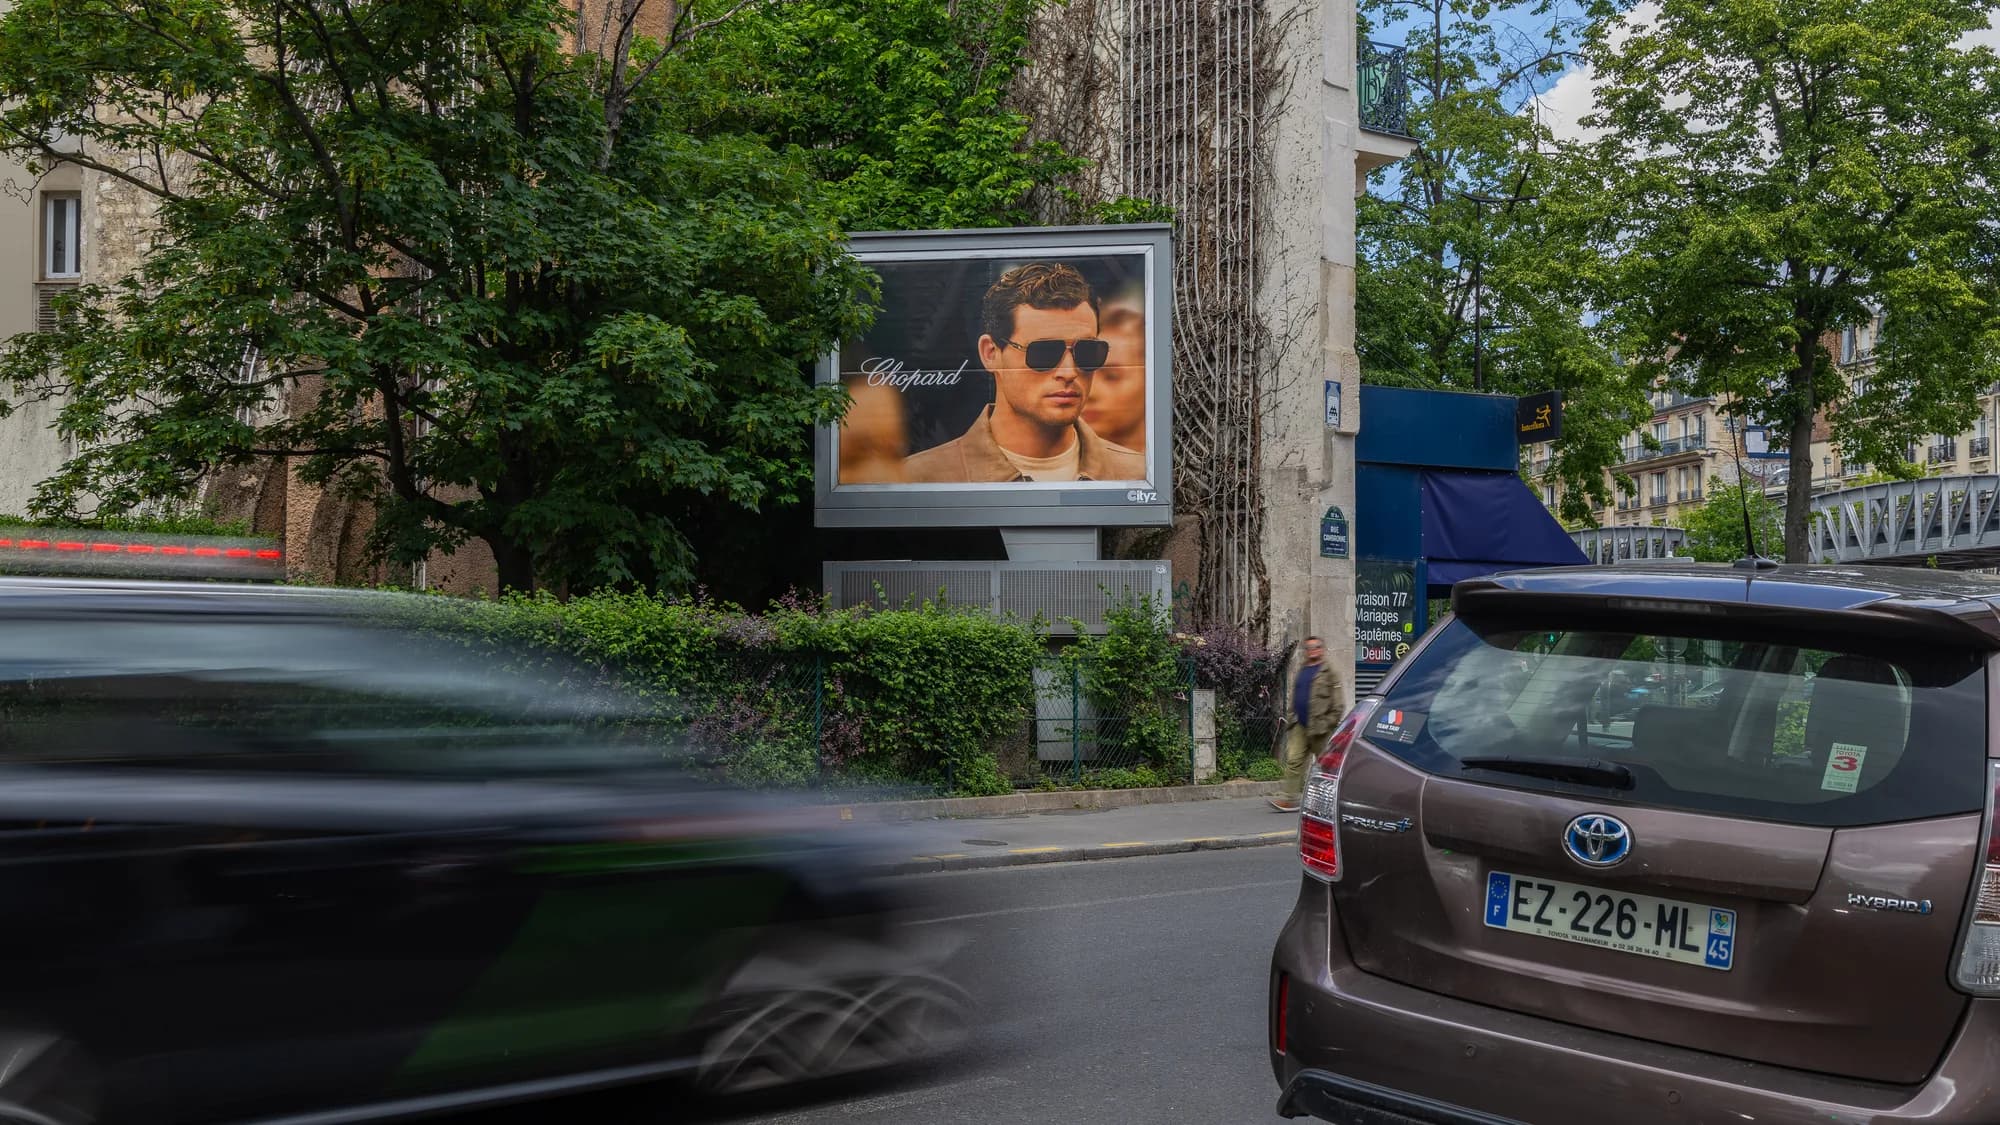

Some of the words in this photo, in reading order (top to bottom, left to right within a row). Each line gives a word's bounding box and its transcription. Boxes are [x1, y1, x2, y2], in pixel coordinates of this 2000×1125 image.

[861, 358, 968, 392] Chopard
[1127, 490, 1157, 503] Cityz
[1356, 590, 1390, 606] vraison
[1392, 592, 1408, 607] 7/7
[1355, 607, 1399, 626] Mariages
[1355, 627, 1402, 644] Baptêmes
[1361, 646, 1392, 661] Deuils
[1836, 750, 1861, 758] TOYOTA
[1832, 756, 1858, 772] 3
[1493, 904, 1501, 917] F
[1847, 893, 1921, 912] HYBRID
[1511, 879, 1700, 953] EZ-226-ML
[1548, 929, 1569, 940] TOYOTA
[1708, 938, 1729, 961] 45
